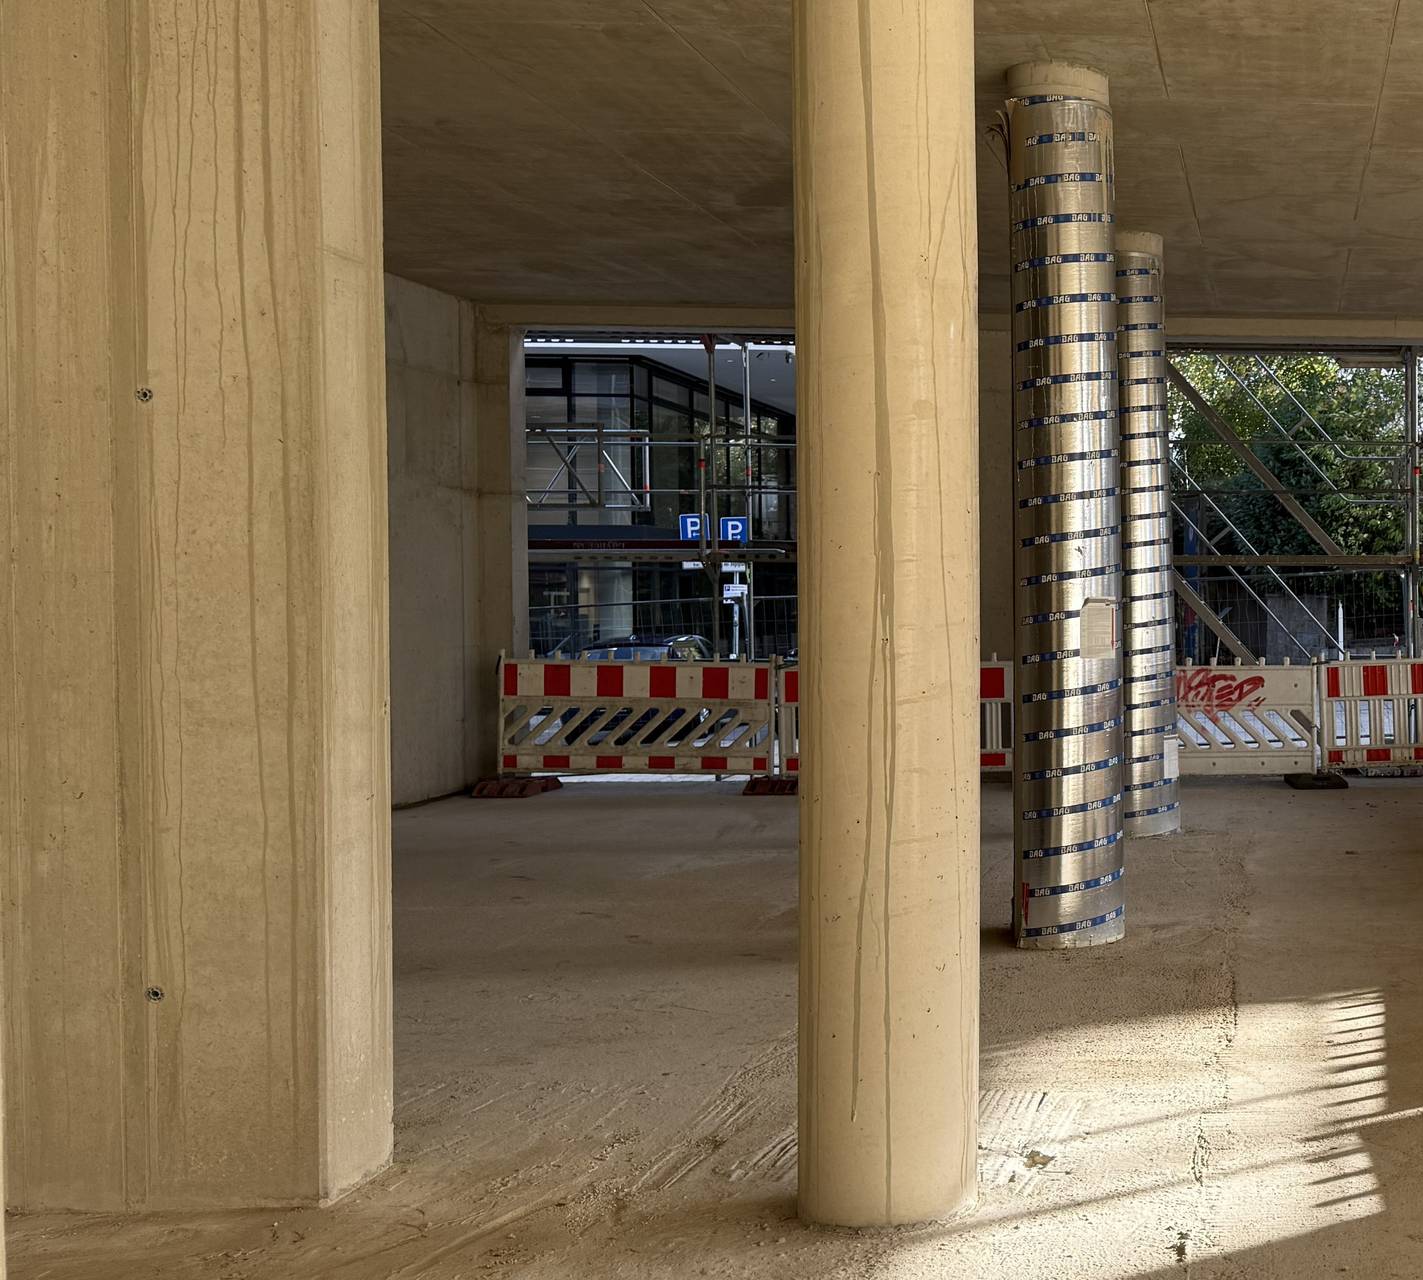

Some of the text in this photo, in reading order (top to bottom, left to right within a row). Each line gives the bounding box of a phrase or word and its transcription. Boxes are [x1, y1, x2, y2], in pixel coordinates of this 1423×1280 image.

[1030, 177, 1045, 186] BAG
[1023, 301, 1036, 309] BAG
[1029, 339, 1044, 347] BAG
[1095, 333, 1106, 341] BAG
[1036, 378, 1051, 386] BAG
[1044, 417, 1059, 425] BAG
[1079, 412, 1093, 420] BAG
[1023, 459, 1035, 468] BAG
[1052, 454, 1068, 462] BAG
[1086, 451, 1100, 459] BAG
[1028, 498, 1042, 506] BAG
[1060, 493, 1076, 501] BAG
[686, 518, 701, 539] P
[727, 520, 743, 540] P
[1035, 528, 1111, 544] BAG BAG BAG
[1042, 574, 1057, 582] BAG
[1076, 570, 1091, 578] BAG
[1049, 612, 1065, 620] BAG
[1027, 650, 1073, 663] BAG BAG
[1033, 693, 1046, 701] BAG
[1098, 683, 1109, 691] BAG
[1104, 720, 1114, 728] BAG
[1088, 802, 1101, 810] BAG
[1029, 850, 1043, 858] BAG
[1094, 838, 1107, 847] BAG
[1035, 875, 1112, 896] BAG BAG BAG
[1042, 912, 1116, 935] BAG BAG BAG
